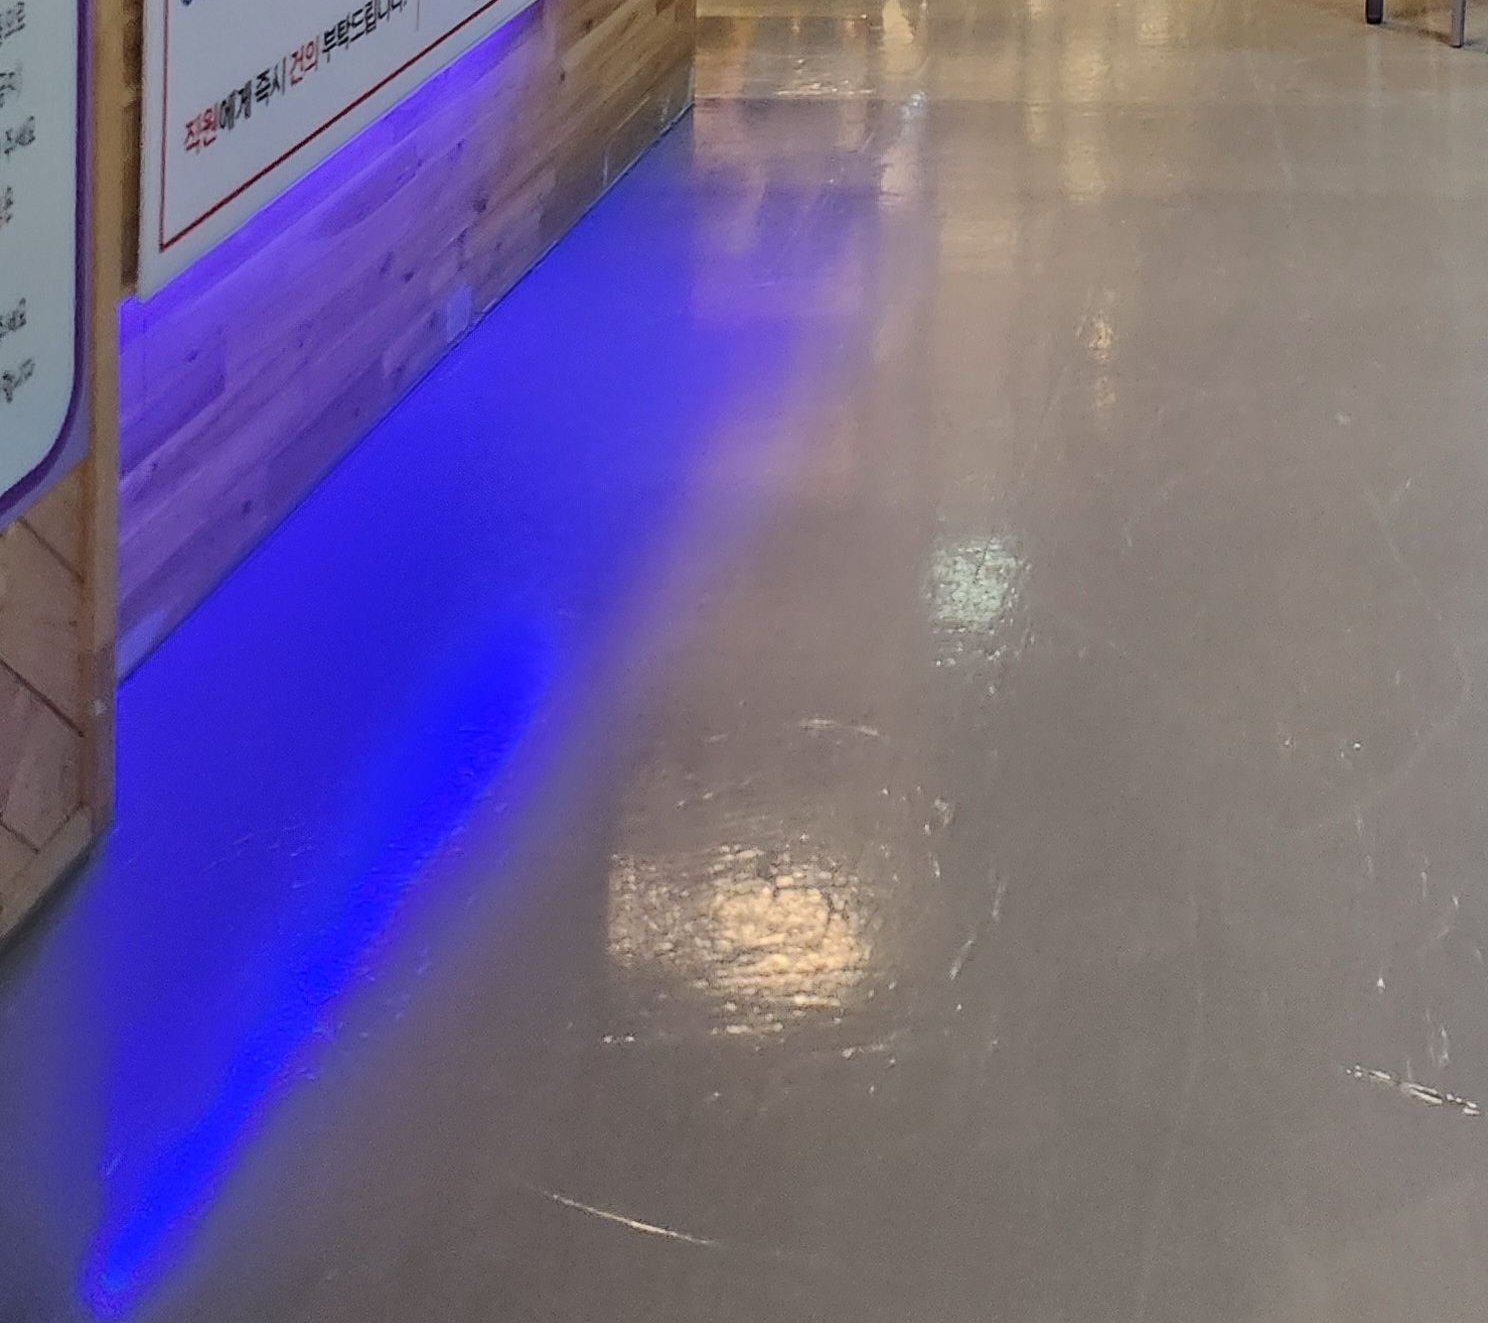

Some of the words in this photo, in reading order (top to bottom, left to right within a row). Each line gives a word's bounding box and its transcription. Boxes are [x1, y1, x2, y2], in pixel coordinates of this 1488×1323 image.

[184, 79, 252, 156] 직원에게
[255, 55, 288, 106] 즉시
[289, 35, 320, 87] 건의
